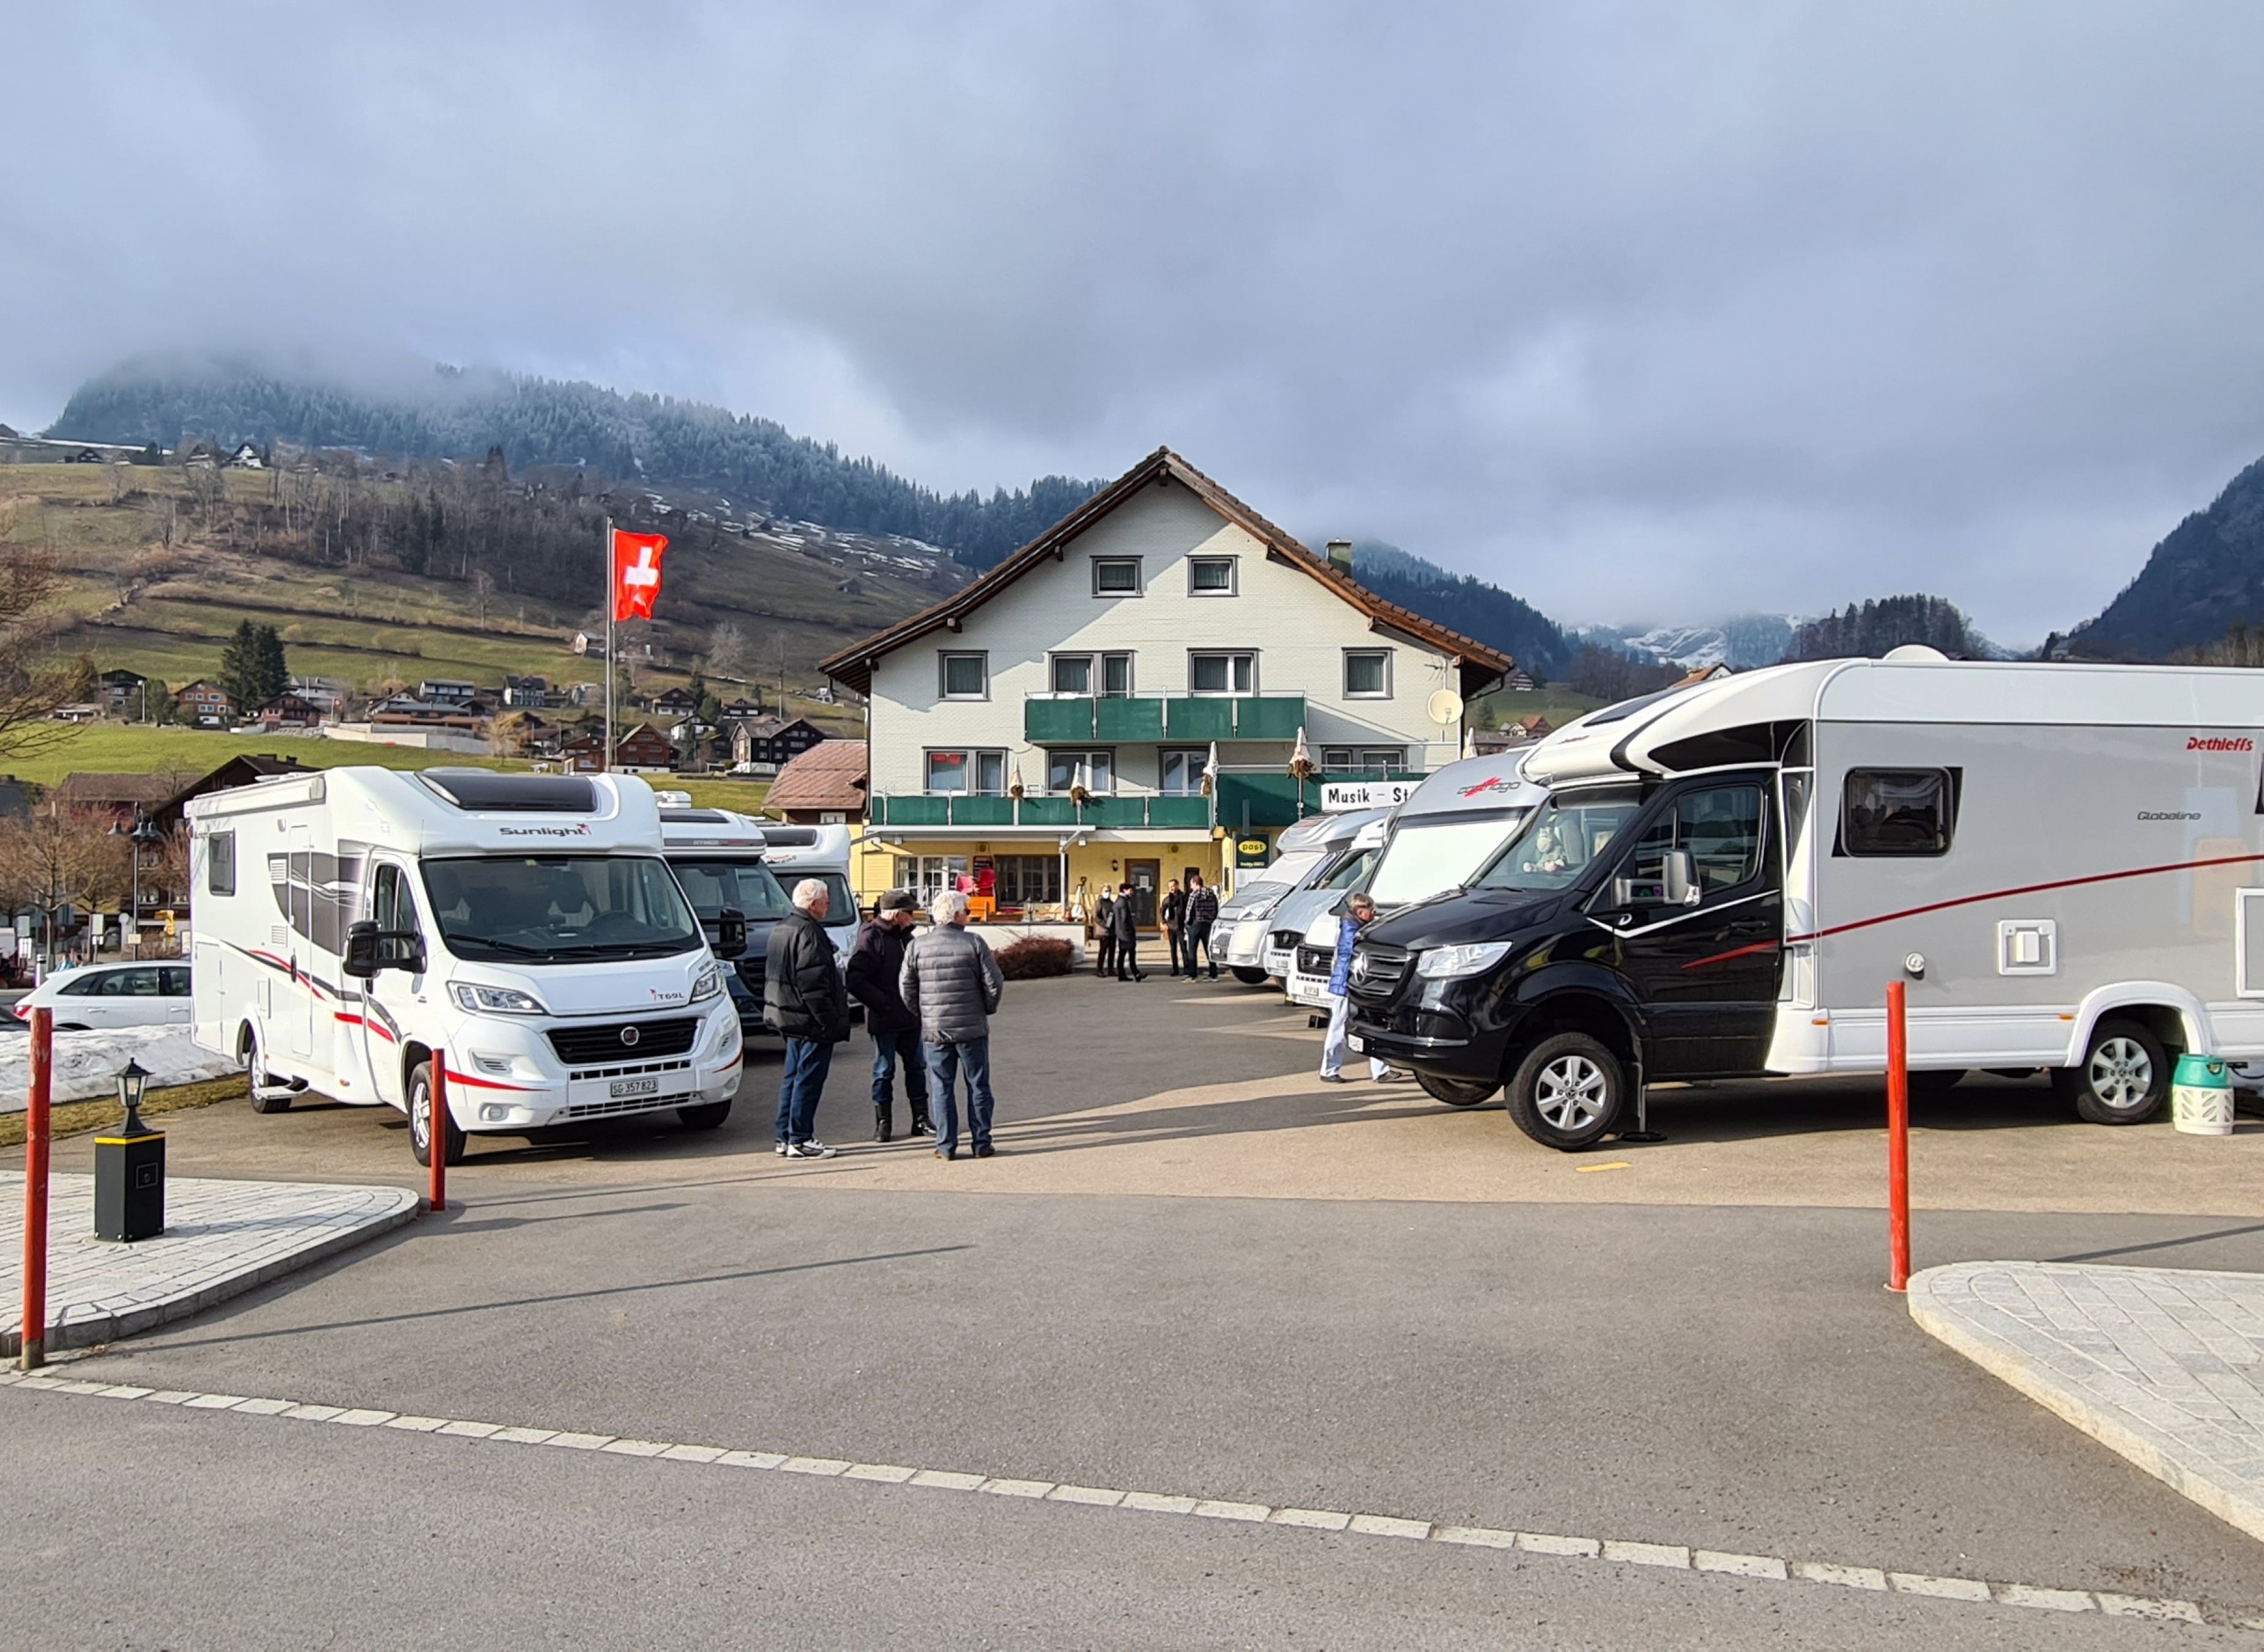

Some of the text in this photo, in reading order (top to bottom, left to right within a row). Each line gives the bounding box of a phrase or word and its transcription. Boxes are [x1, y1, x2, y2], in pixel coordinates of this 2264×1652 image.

[2186, 736, 2254, 751] Dethleffs
[1328, 787, 1370, 803] Musik
[1393, 786, 1412, 803] St
[1457, 777, 1522, 797] caago
[499, 825, 587, 837] Sunlight
